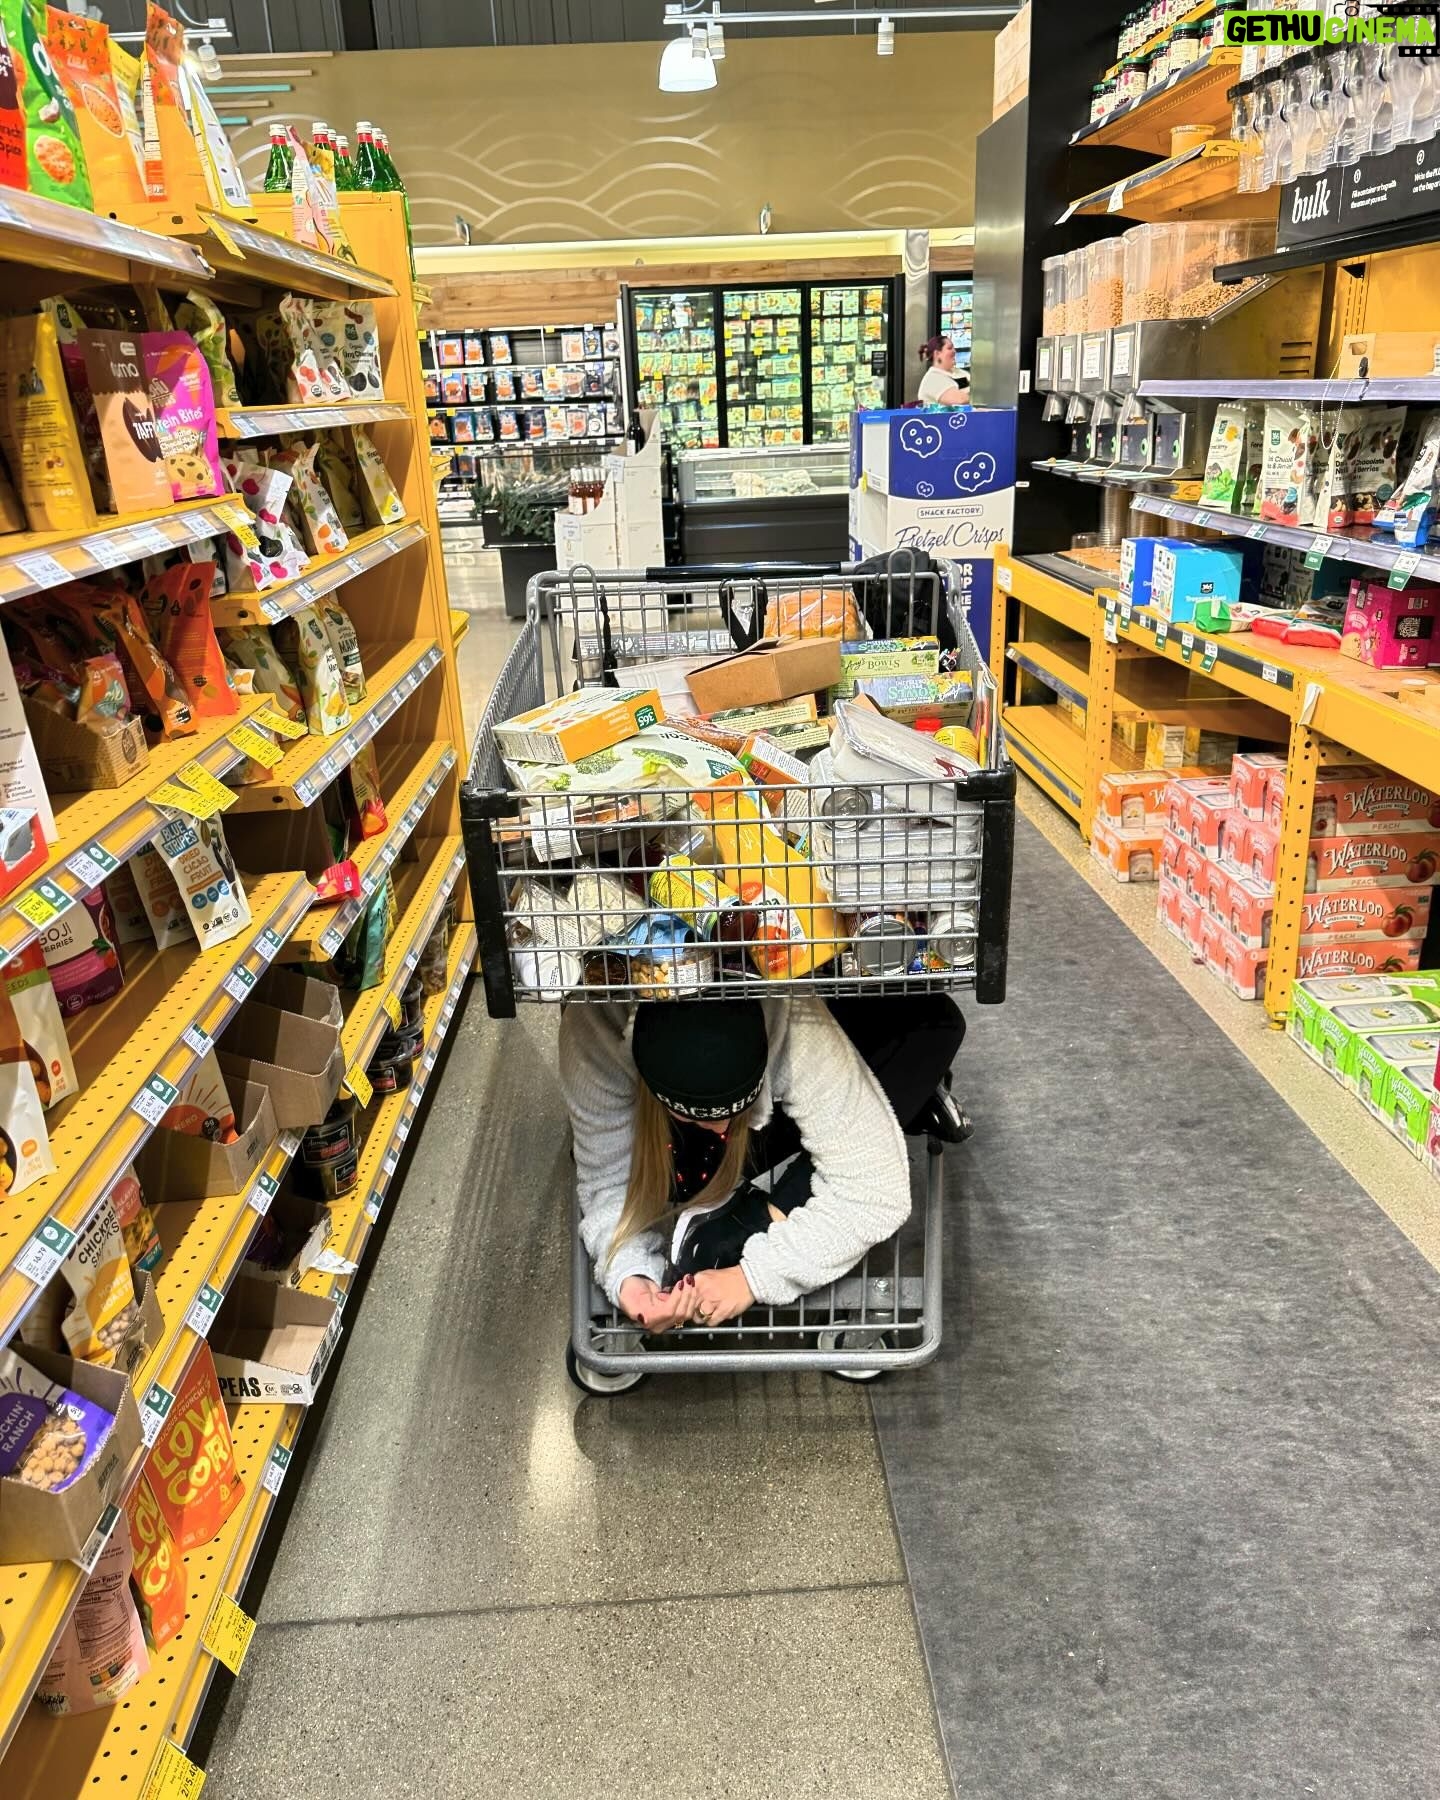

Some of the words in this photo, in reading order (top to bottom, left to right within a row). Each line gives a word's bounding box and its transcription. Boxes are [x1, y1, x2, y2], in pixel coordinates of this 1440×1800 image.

[1292, 178, 1331, 224] bulk
[894, 524, 954, 552] Pretzel
[953, 522, 1004, 551] Crisps
[638, 711, 655, 727] 365
[1344, 784, 1429, 819] WATERLOO
[163, 820, 187, 838] BLUE
[164, 831, 198, 857] STRIPES
[178, 847, 201, 864] DRIED
[1324, 839, 1408, 875] WATERLOO
[190, 865, 213, 881] FRUIT
[1351, 878, 1379, 886] PEACH
[1302, 896, 1384, 930] WATERLOO
[1328, 933, 1356, 941] PEACH
[1298, 947, 1375, 978] WATERLOO
[79, 1207, 117, 1264] CHICKPE
[220, 1376, 261, 1398] PEAS
[2, 1410, 35, 1453] RANCH
